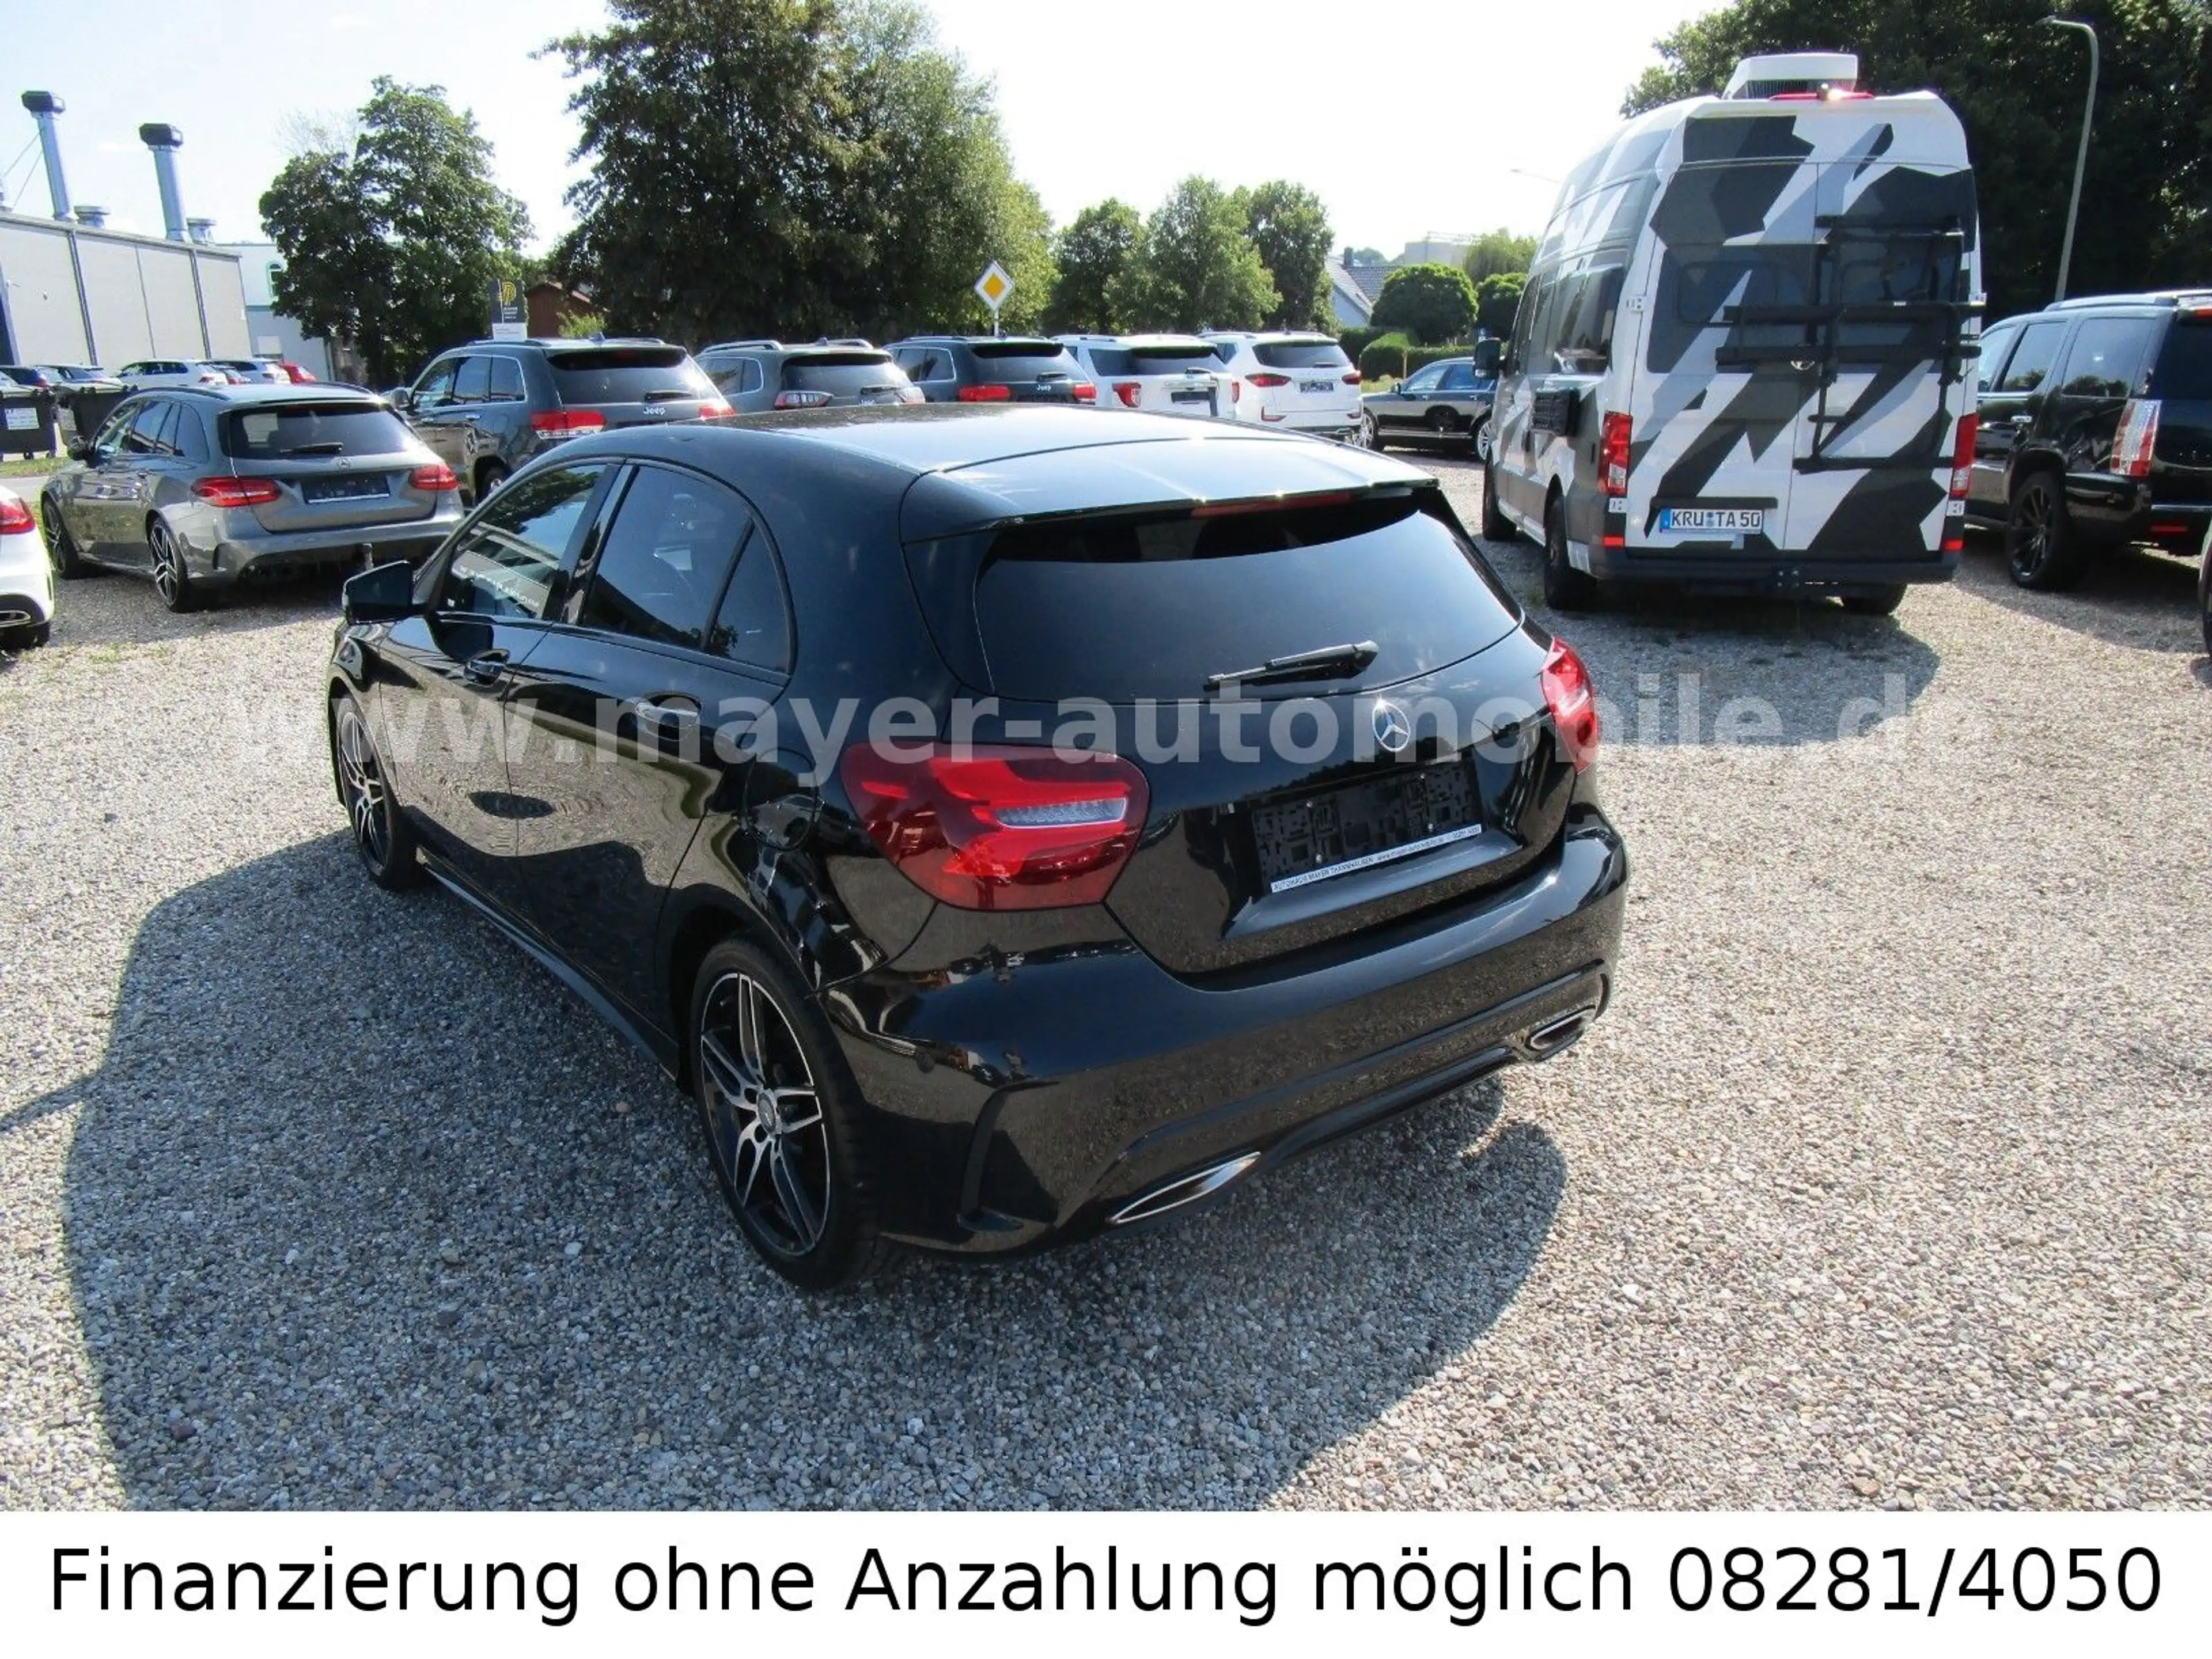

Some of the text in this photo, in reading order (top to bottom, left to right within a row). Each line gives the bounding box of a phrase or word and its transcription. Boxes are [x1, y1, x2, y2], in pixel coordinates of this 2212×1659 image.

[1672, 512, 1761, 527] KRU TA 50
